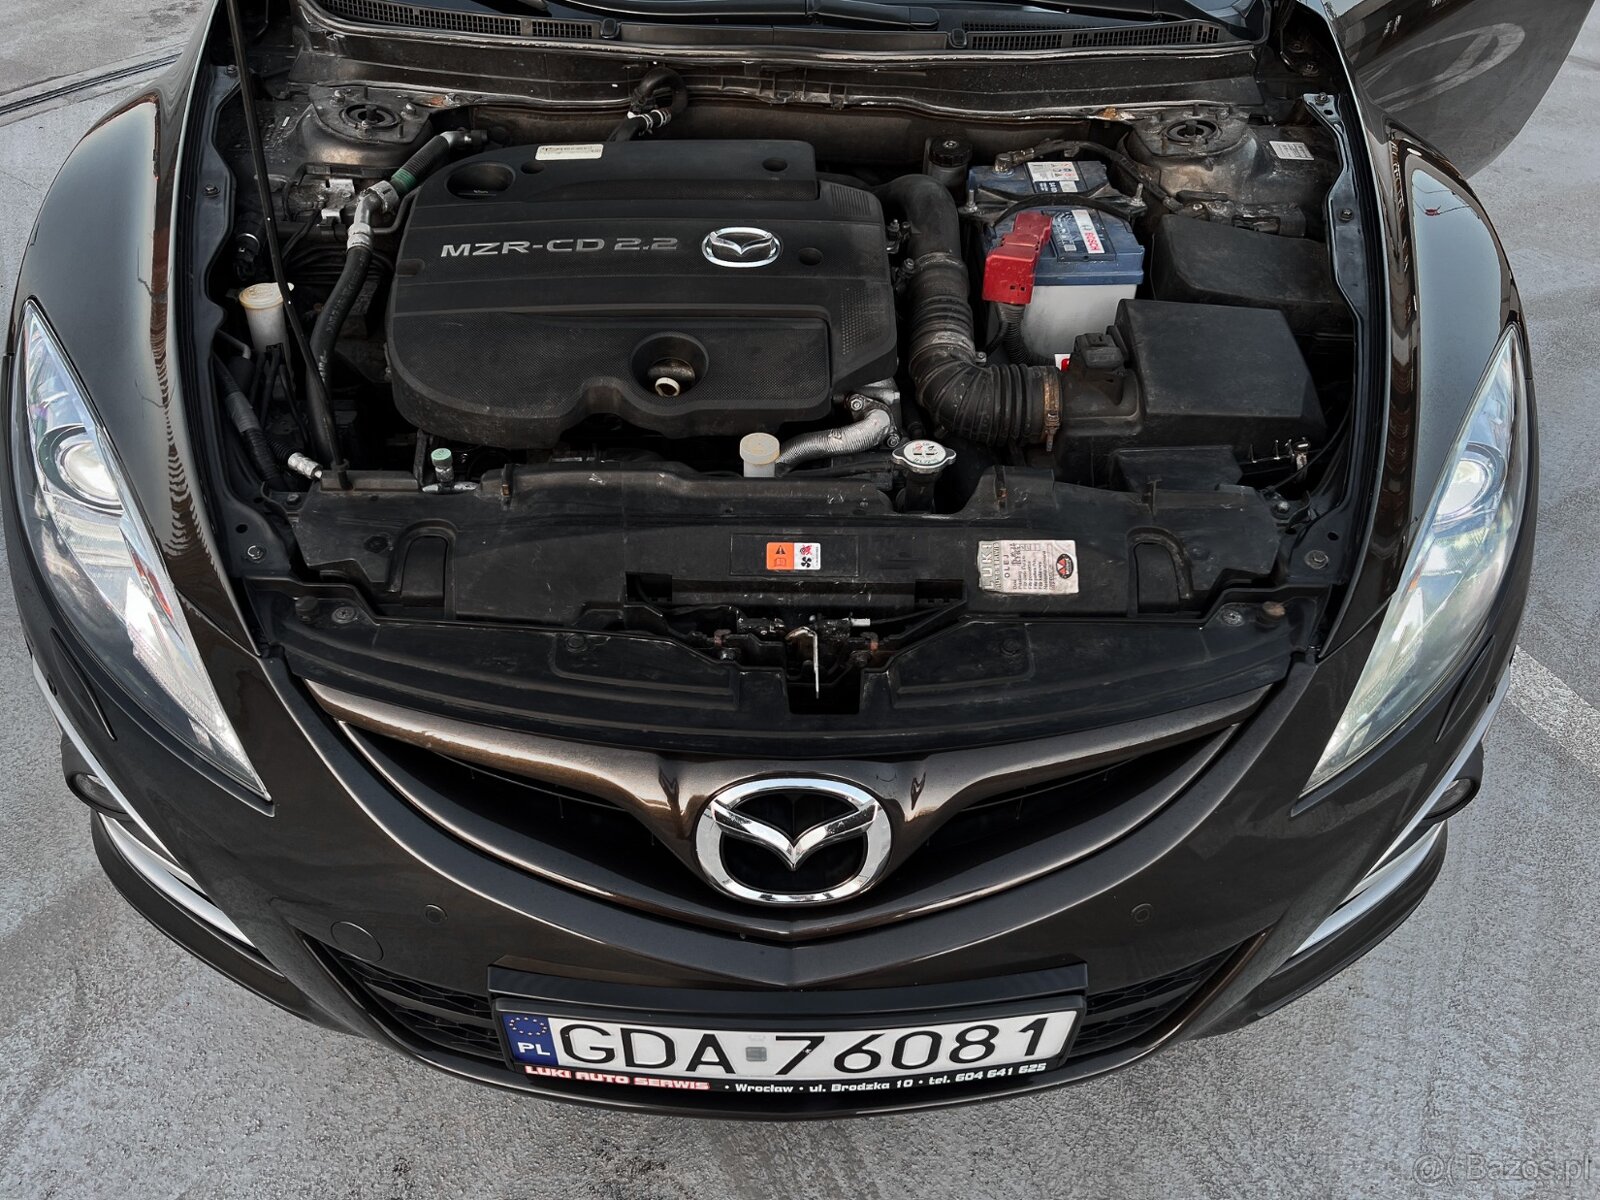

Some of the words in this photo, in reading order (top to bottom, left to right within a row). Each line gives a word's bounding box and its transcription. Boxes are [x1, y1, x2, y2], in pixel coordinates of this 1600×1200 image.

[440, 238, 605, 258] MZR-CD
[614, 237, 678, 251] 2.2
[1085, 232, 1101, 250] BOSCH
[1003, 554, 1011, 579] OLEJ
[517, 1041, 550, 1056] PL
[559, 1023, 736, 1075] GDA
[775, 1017, 1049, 1076] 76081
[525, 1065, 572, 1079] LUKI
[575, 1071, 630, 1085] AUTO
[634, 1076, 710, 1090] SERWIS
[809, 1084, 826, 1092] ul.
[831, 1081, 890, 1092] Brodzka
[896, 1079, 913, 1088] 10
[929, 1075, 950, 1085] tel.
[955, 1071, 983, 1082] 604
[987, 1067, 1013, 1078] 641
[1018, 1062, 1047, 1074] 625
